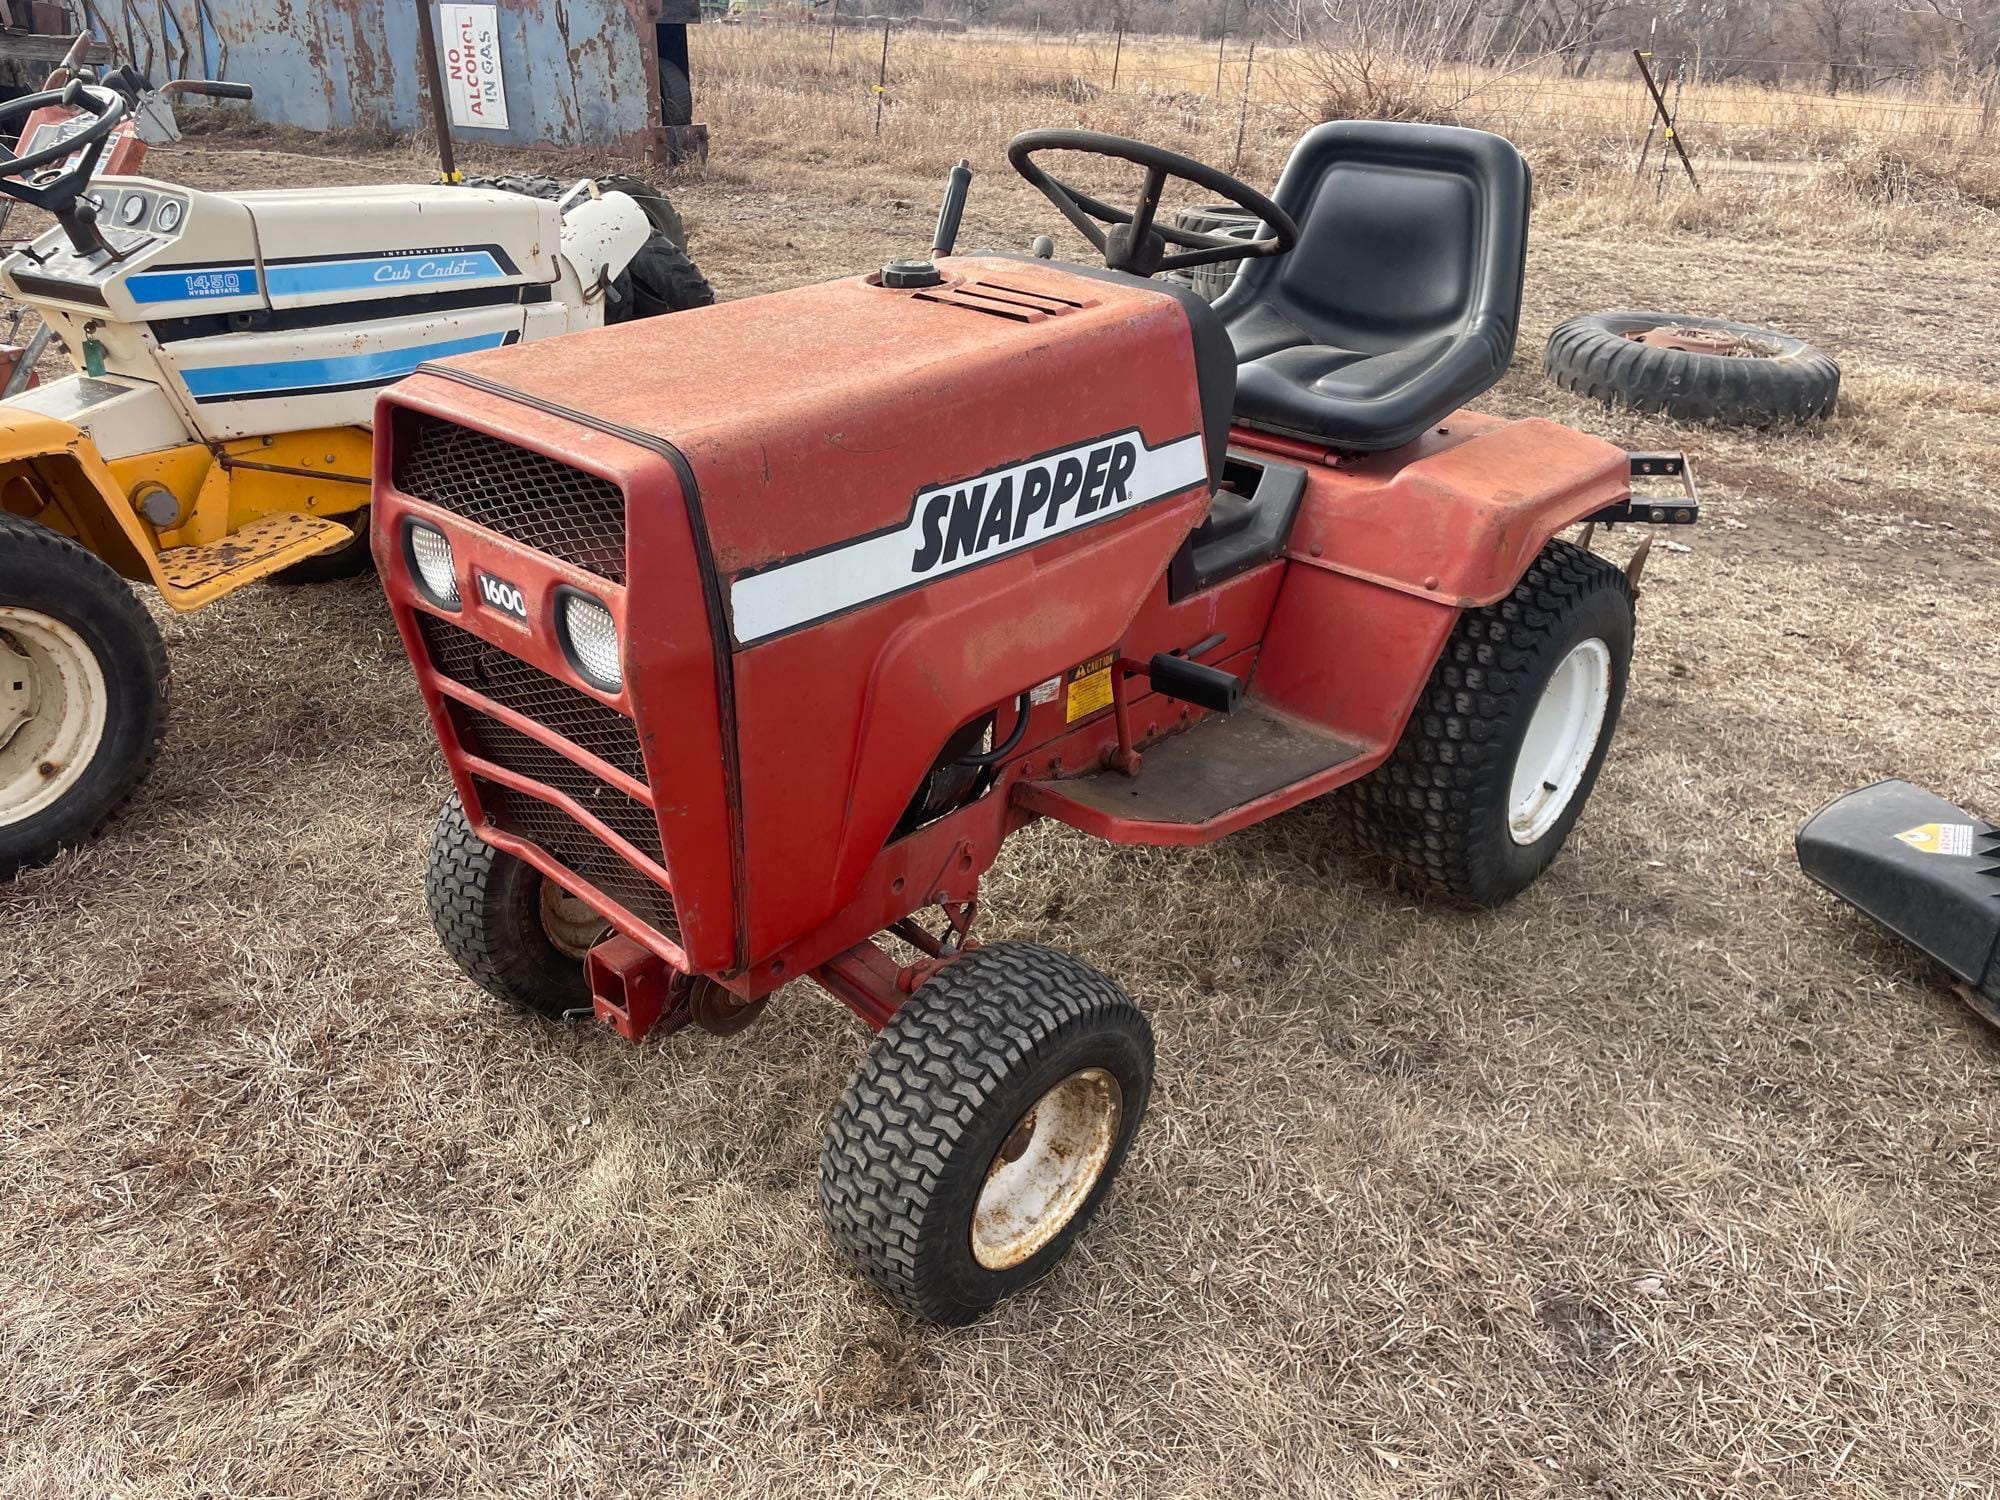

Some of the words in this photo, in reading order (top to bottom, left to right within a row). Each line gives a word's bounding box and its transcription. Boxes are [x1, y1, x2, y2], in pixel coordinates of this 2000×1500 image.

[448, 48, 462, 80] NO
[480, 30, 494, 75] GAS
[462, 16, 483, 116] ALCOHOL
[484, 80, 497, 103] IN
[383, 247, 465, 257] INTERNATIONAL
[185, 273, 239, 291] 1450
[374, 264, 411, 282] Cub
[417, 260, 478, 278] Cadet
[188, 287, 240, 296] HYDROSTATIC
[911, 441, 1137, 573] SNAPPER
[480, 575, 527, 617] 1600
[1086, 654, 1114, 674] CAUTION
